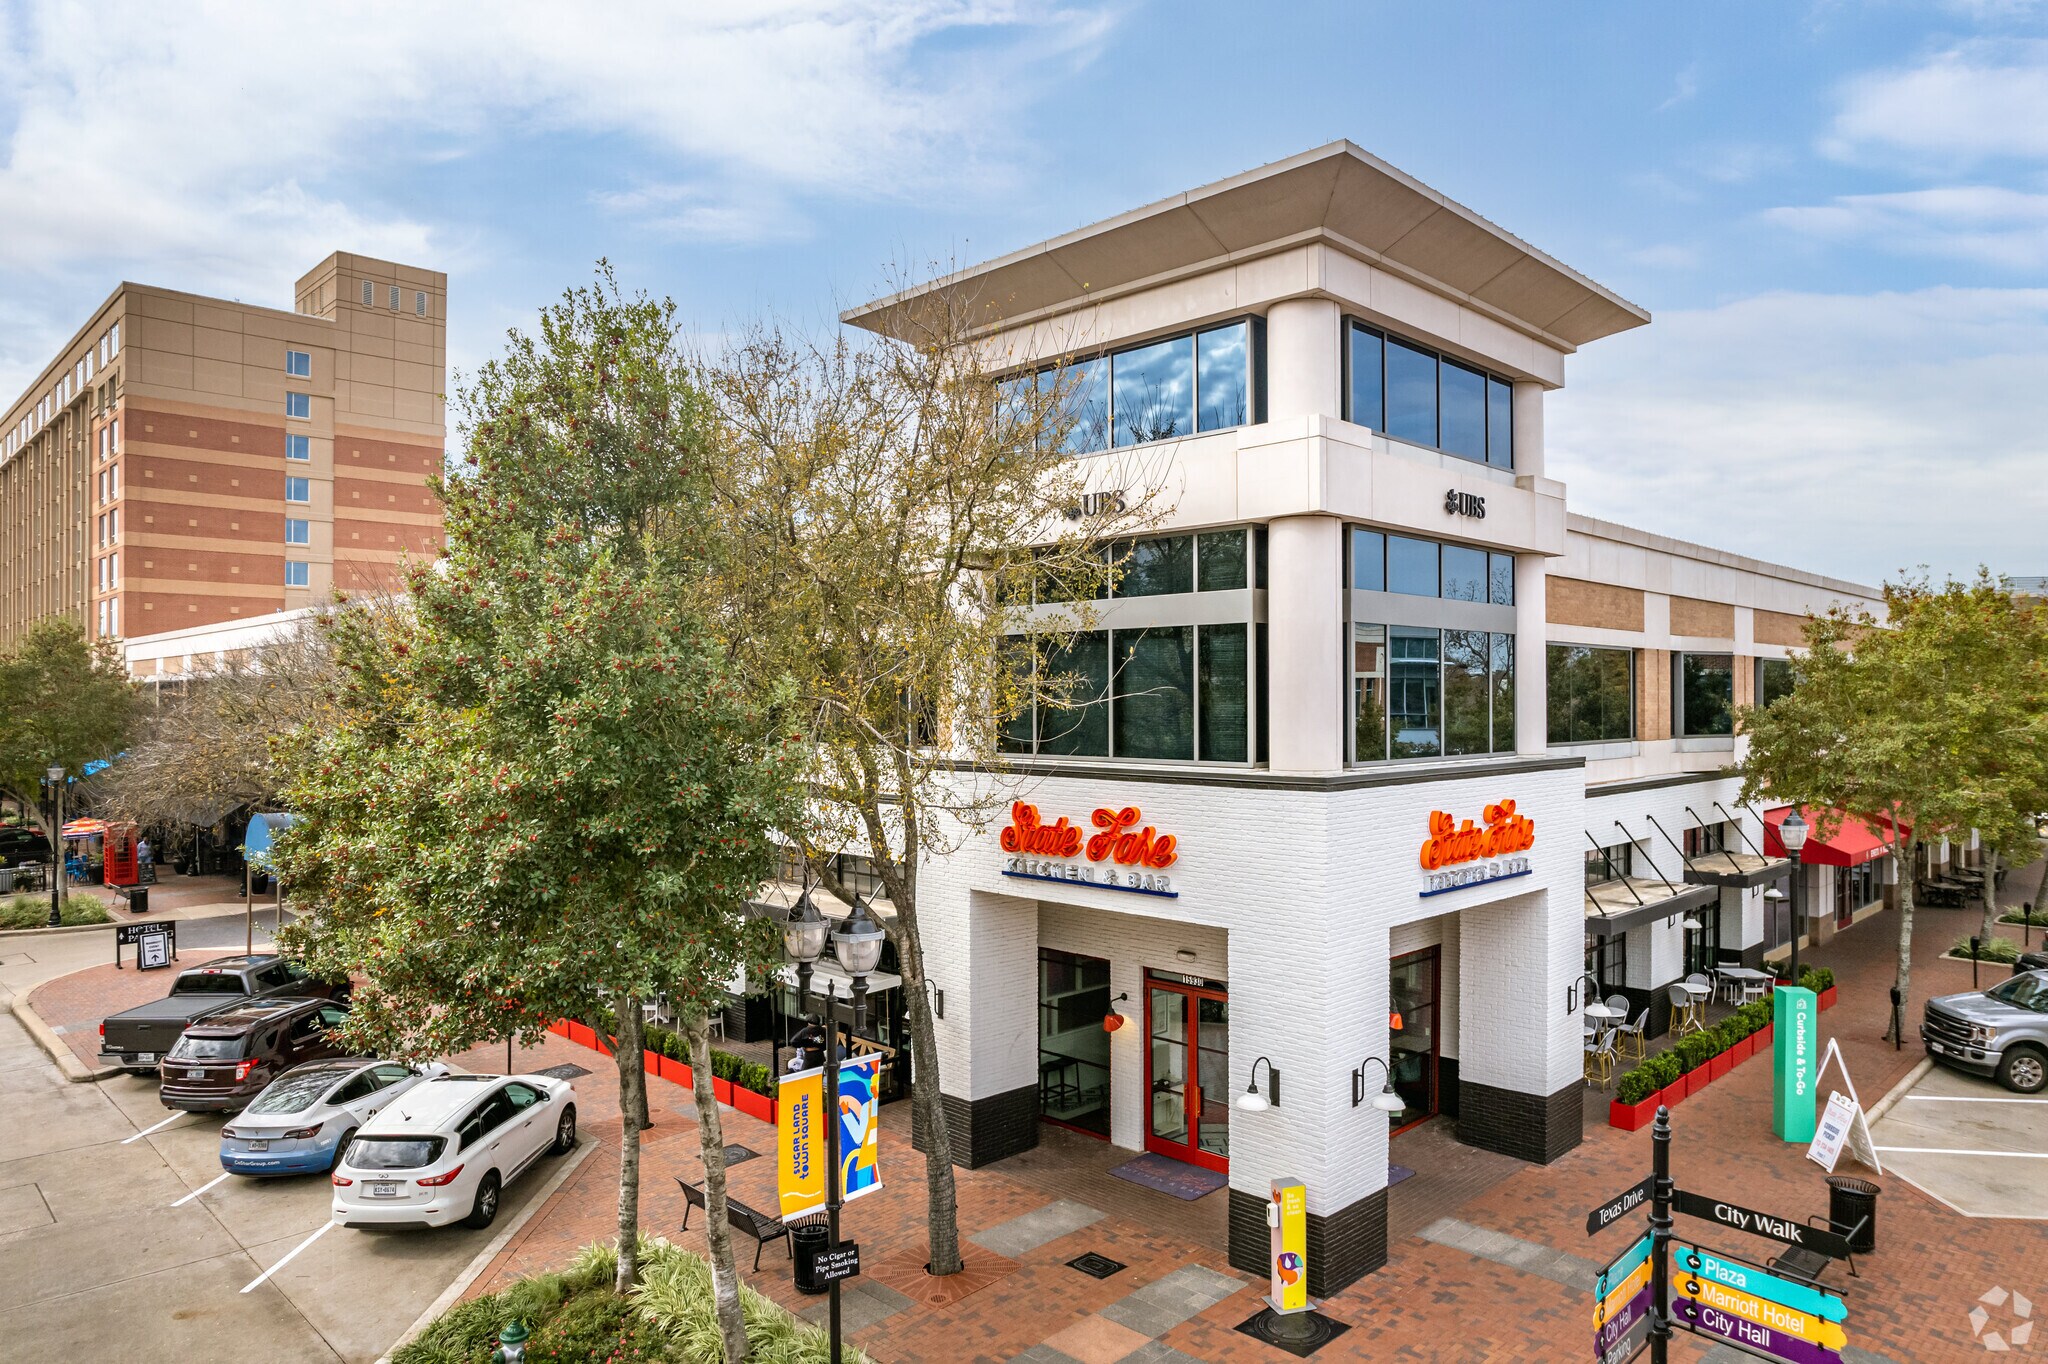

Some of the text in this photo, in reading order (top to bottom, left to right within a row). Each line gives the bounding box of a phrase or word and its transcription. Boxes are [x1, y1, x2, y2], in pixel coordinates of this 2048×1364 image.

[1457, 491, 1486, 519] UBS
[1000, 800, 1178, 869] State Fare
[1419, 798, 1535, 870] State Fare
[1006, 858, 1172, 892] KITCHEN & BAR
[1424, 864, 1490, 892] KITCHEN
[1796, 1012, 1807, 1056] Curbside
[1796, 1066, 1806, 1096] To-Go
[801, 1093, 809, 1140] SQUARE
[793, 1104, 801, 1175] SUGAR LAND
[1598, 1188, 1644, 1226] Texas Drive
[1714, 1203, 1804, 1244] City Walk
[815, 1257, 858, 1274] Pipe Smoking
[817, 1255, 828, 1264] No
[829, 1252, 846, 1261] Cigar
[824, 1266, 850, 1280] Allowed
[1704, 1258, 1747, 1288] Plaza
[1605, 1304, 1632, 1342] City Hall
[1702, 1283, 1805, 1334] Marriott Hotel
[1702, 1308, 1771, 1348] City Hall
[1607, 1337, 1631, 1364] Parking
